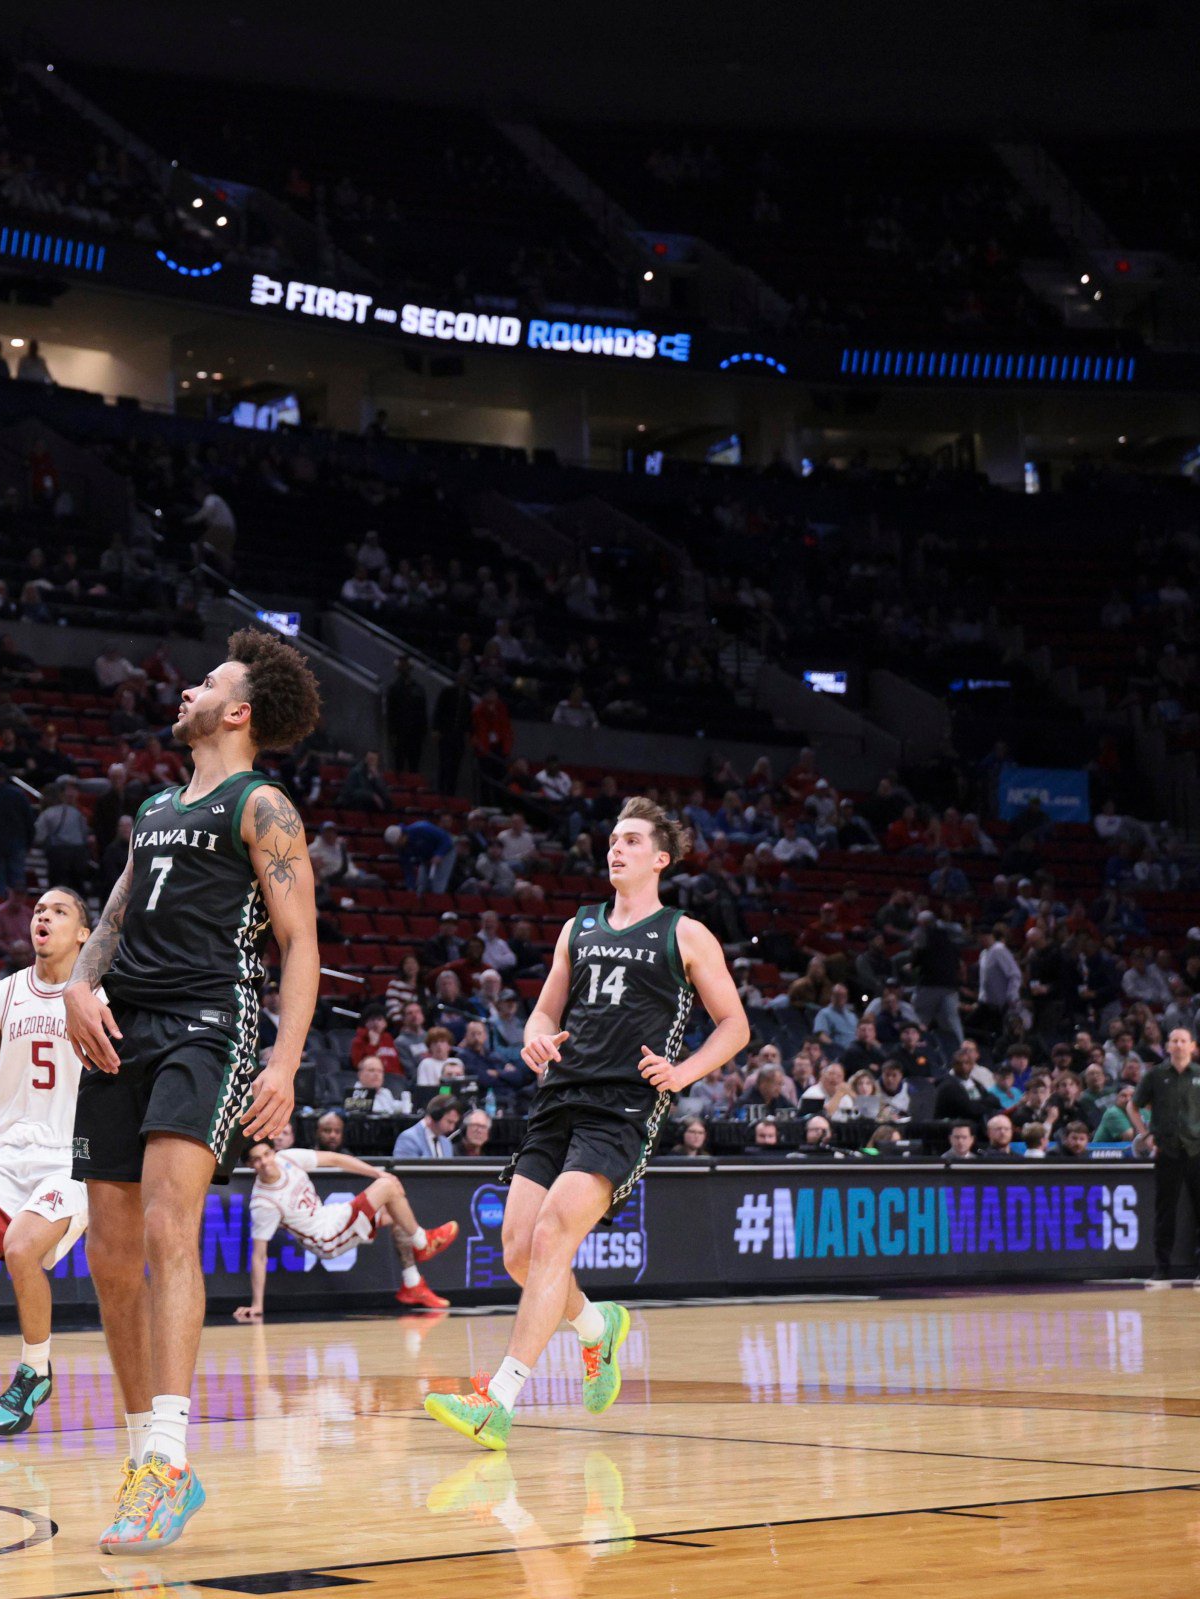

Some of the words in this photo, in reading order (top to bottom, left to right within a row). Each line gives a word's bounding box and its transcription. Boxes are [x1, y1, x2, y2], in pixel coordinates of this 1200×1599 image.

[285, 281, 373, 323] FIRST
[400, 304, 521, 346] SECOND
[527, 319, 657, 359] ROUNDS
[145, 856, 173, 911] 7
[587, 964, 628, 1005] 14
[9, 1016, 70, 1042] RAZORBAC
[31, 1041, 56, 1090] 5
[734, 1184, 1139, 1259] #MARCHMADNESS
